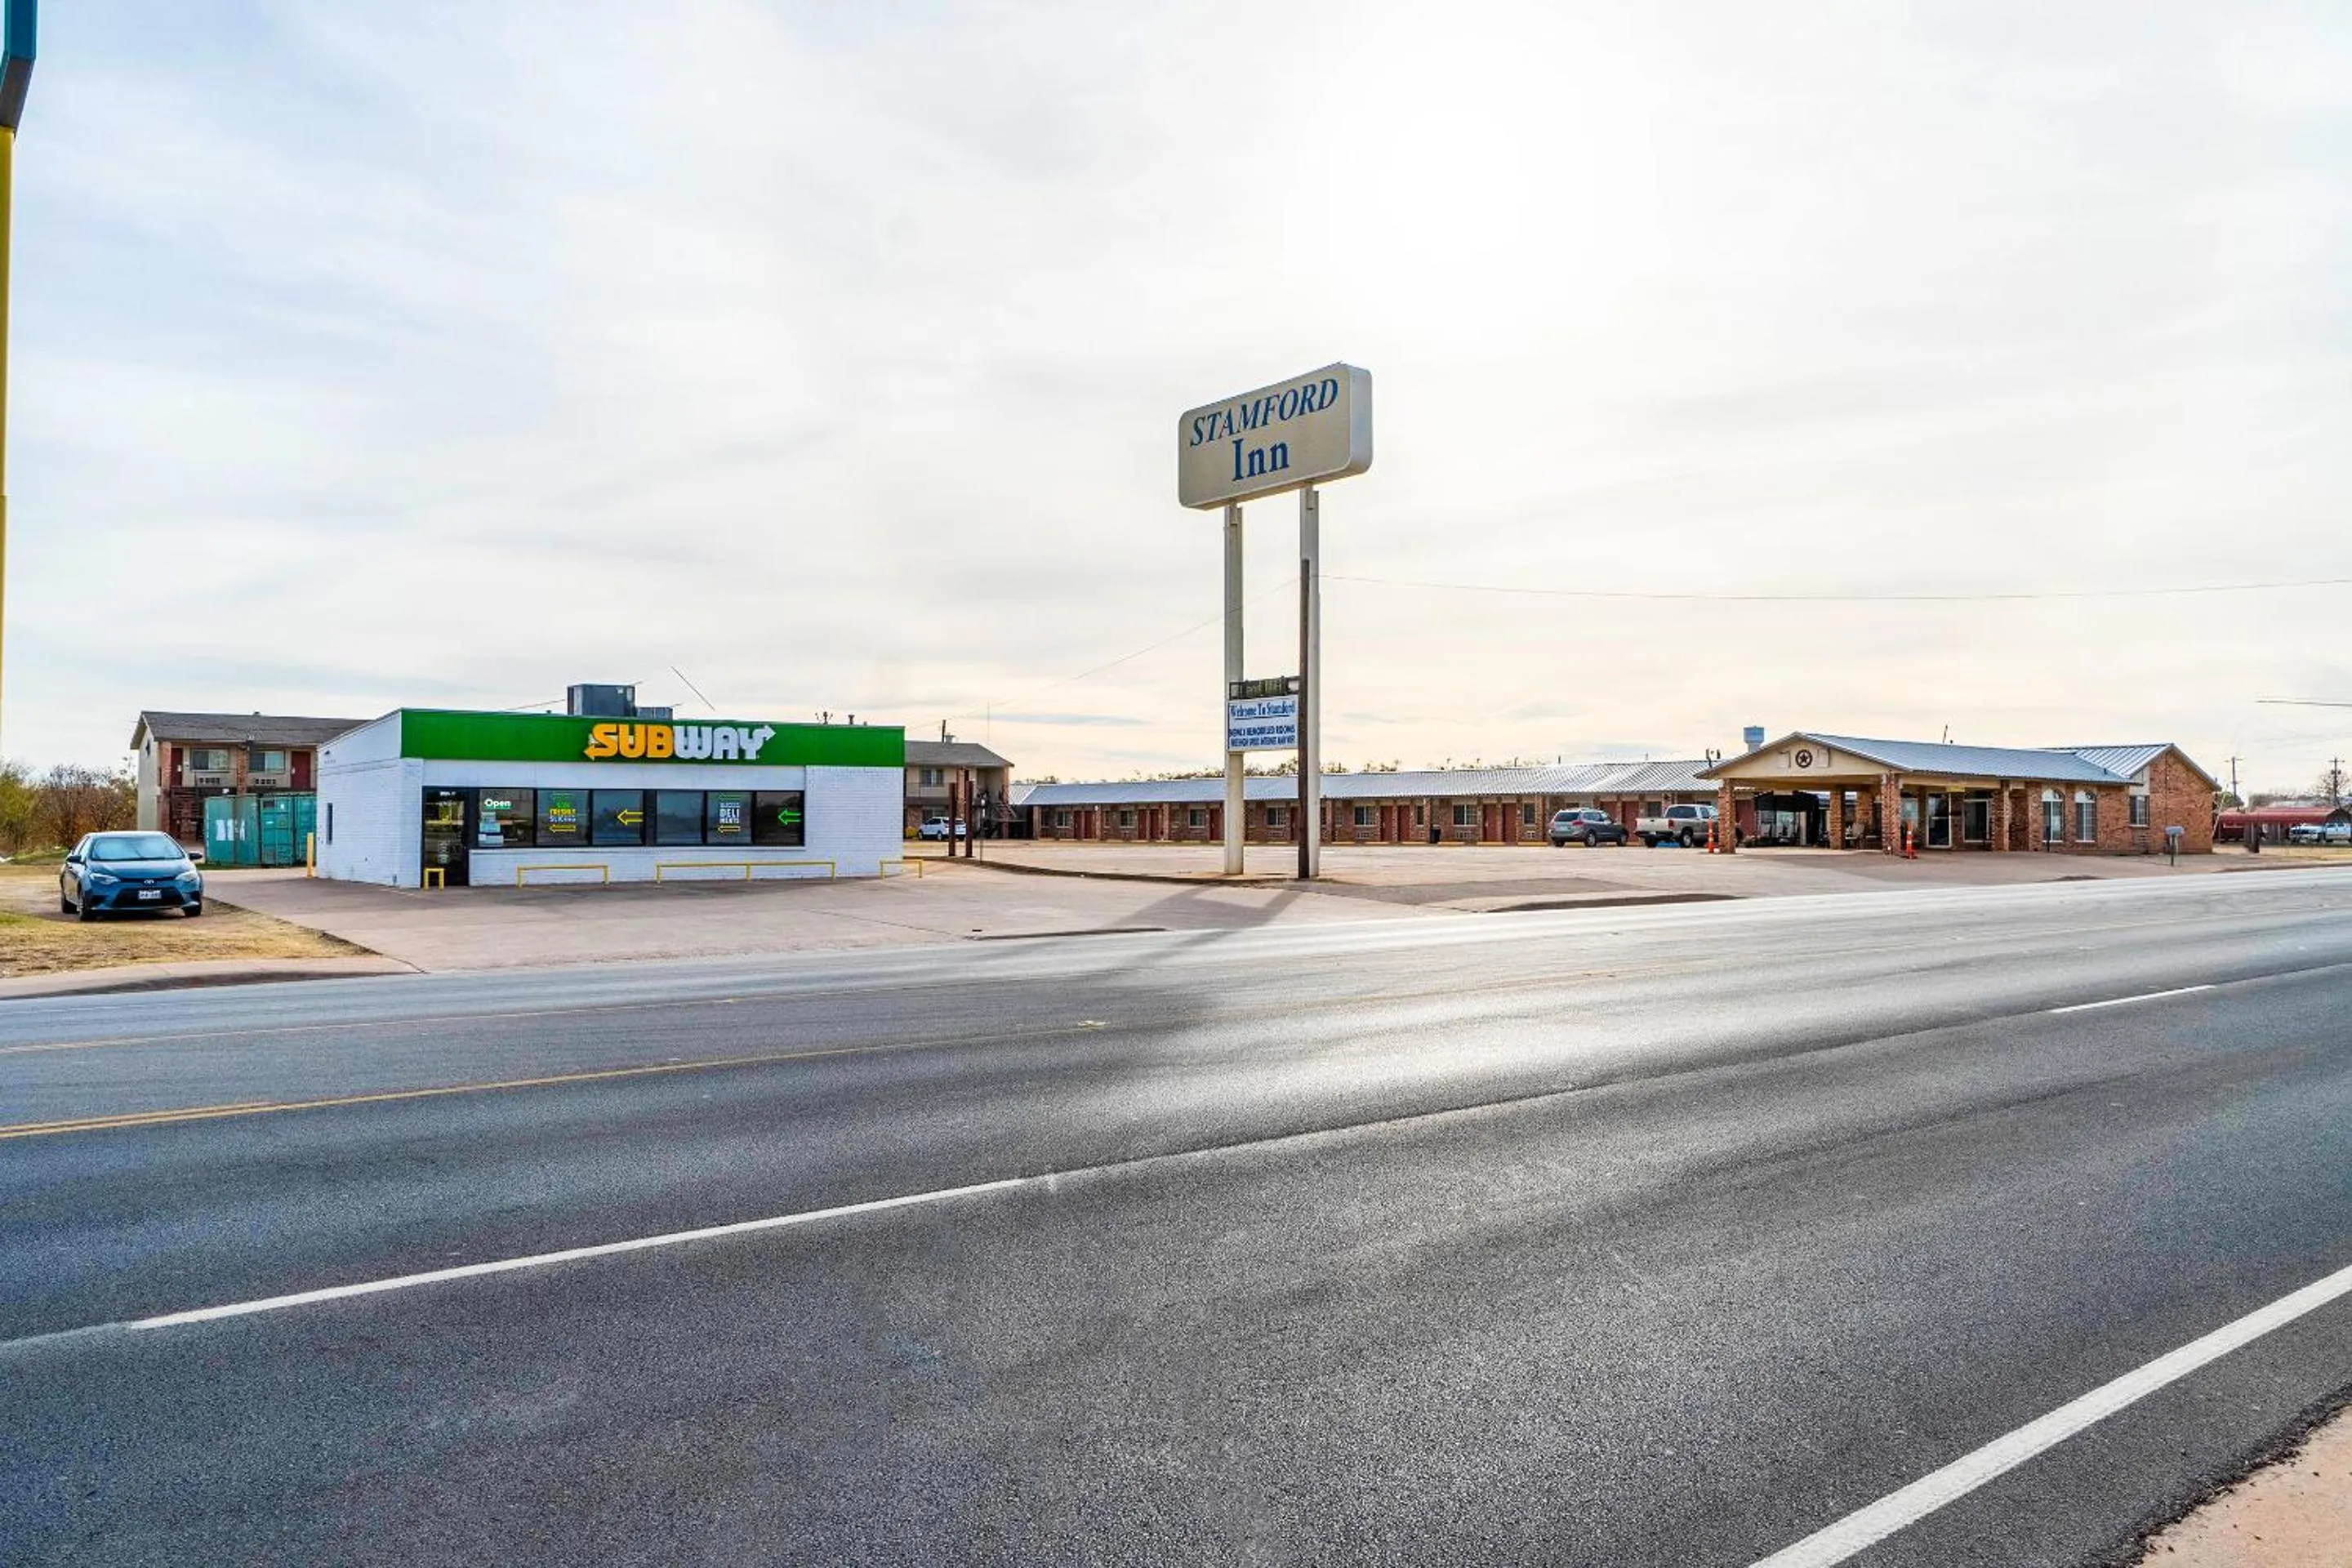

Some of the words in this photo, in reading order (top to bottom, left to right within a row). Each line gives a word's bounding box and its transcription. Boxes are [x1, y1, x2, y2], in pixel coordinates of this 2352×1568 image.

[1190, 378, 1339, 448] STAMFORD
[1232, 438, 1290, 482] Inn
[1231, 705, 1257, 717] Welcome
[1258, 703, 1267, 715] To
[1267, 701, 1295, 715] Stamford
[1276, 724, 1295, 734] ROOMS
[583, 723, 777, 761] SUBWAY
[483, 798, 511, 809] Open
[719, 808, 740, 818] DELI
